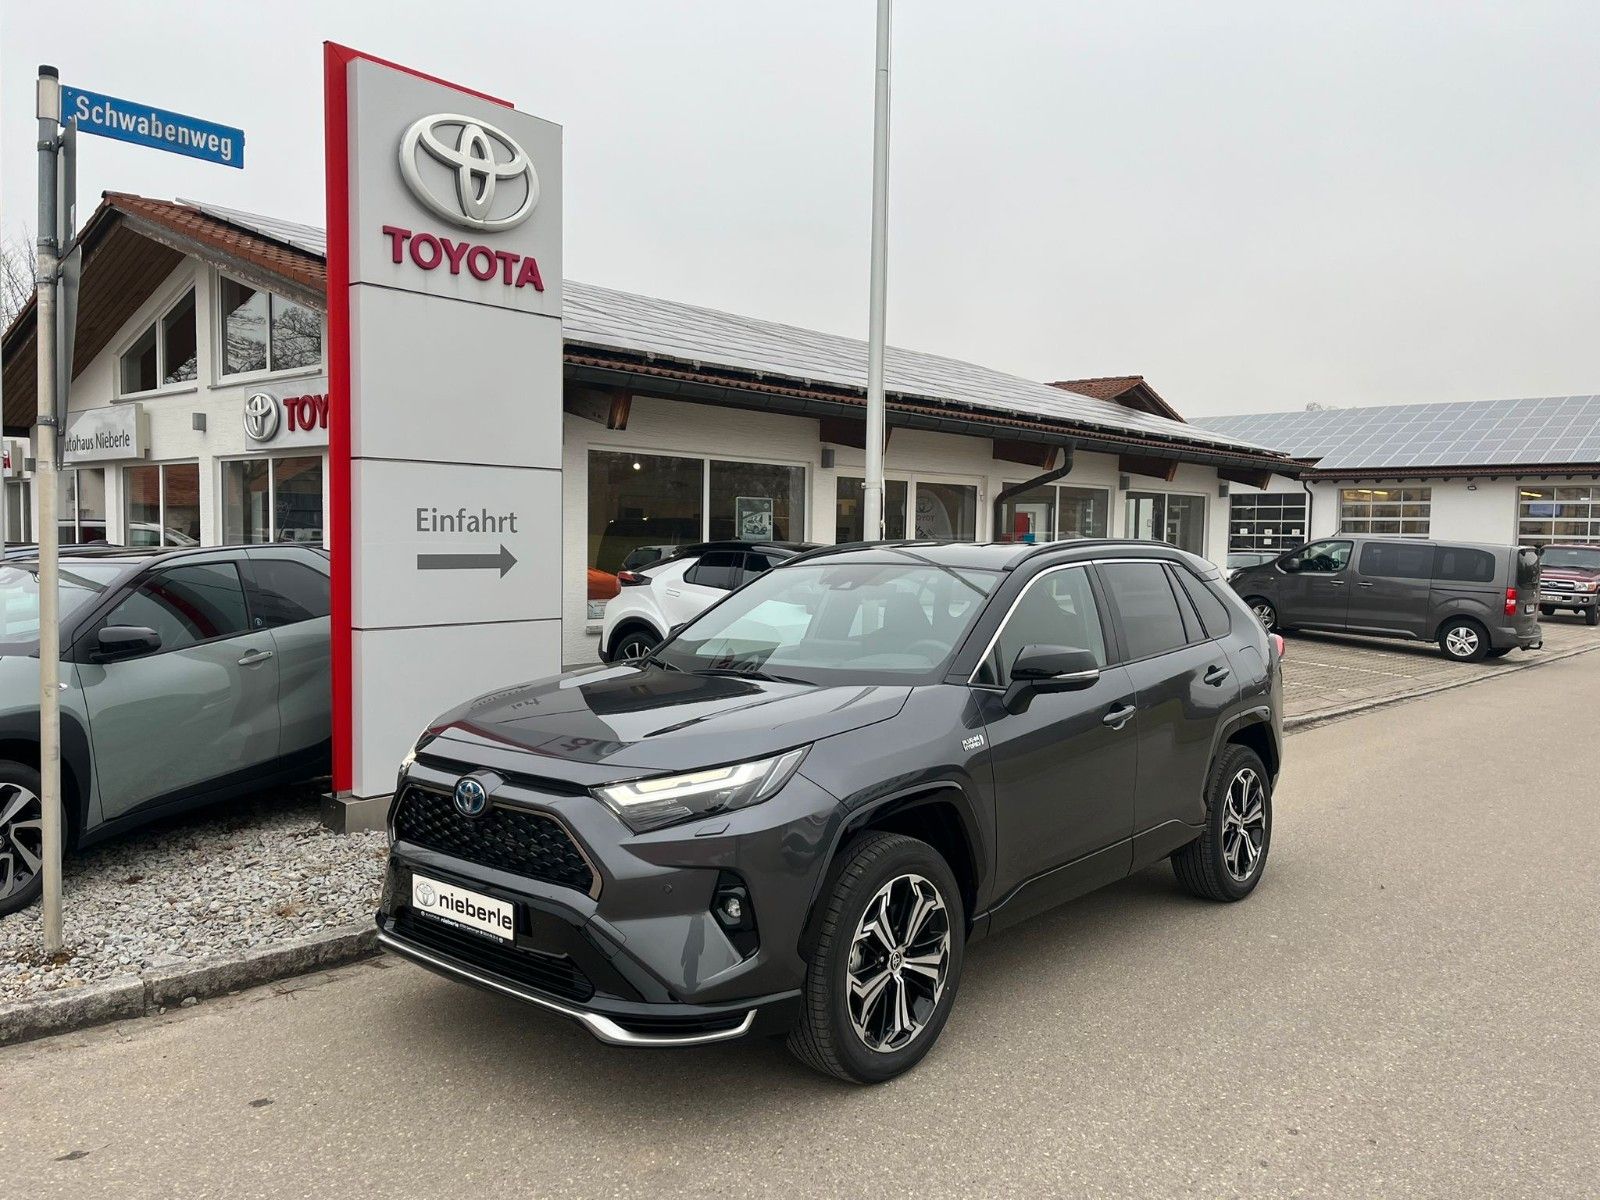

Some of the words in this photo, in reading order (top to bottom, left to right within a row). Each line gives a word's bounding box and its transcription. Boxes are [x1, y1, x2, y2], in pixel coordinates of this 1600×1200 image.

[76, 95, 232, 161] Schwabenweg
[382, 224, 545, 293] TOYOTA
[282, 393, 329, 432] TOY
[64, 434, 94, 452] utohaus
[95, 428, 131, 449] Nieberle
[416, 507, 518, 534] Einfahrt
[438, 892, 513, 931] nieberle
